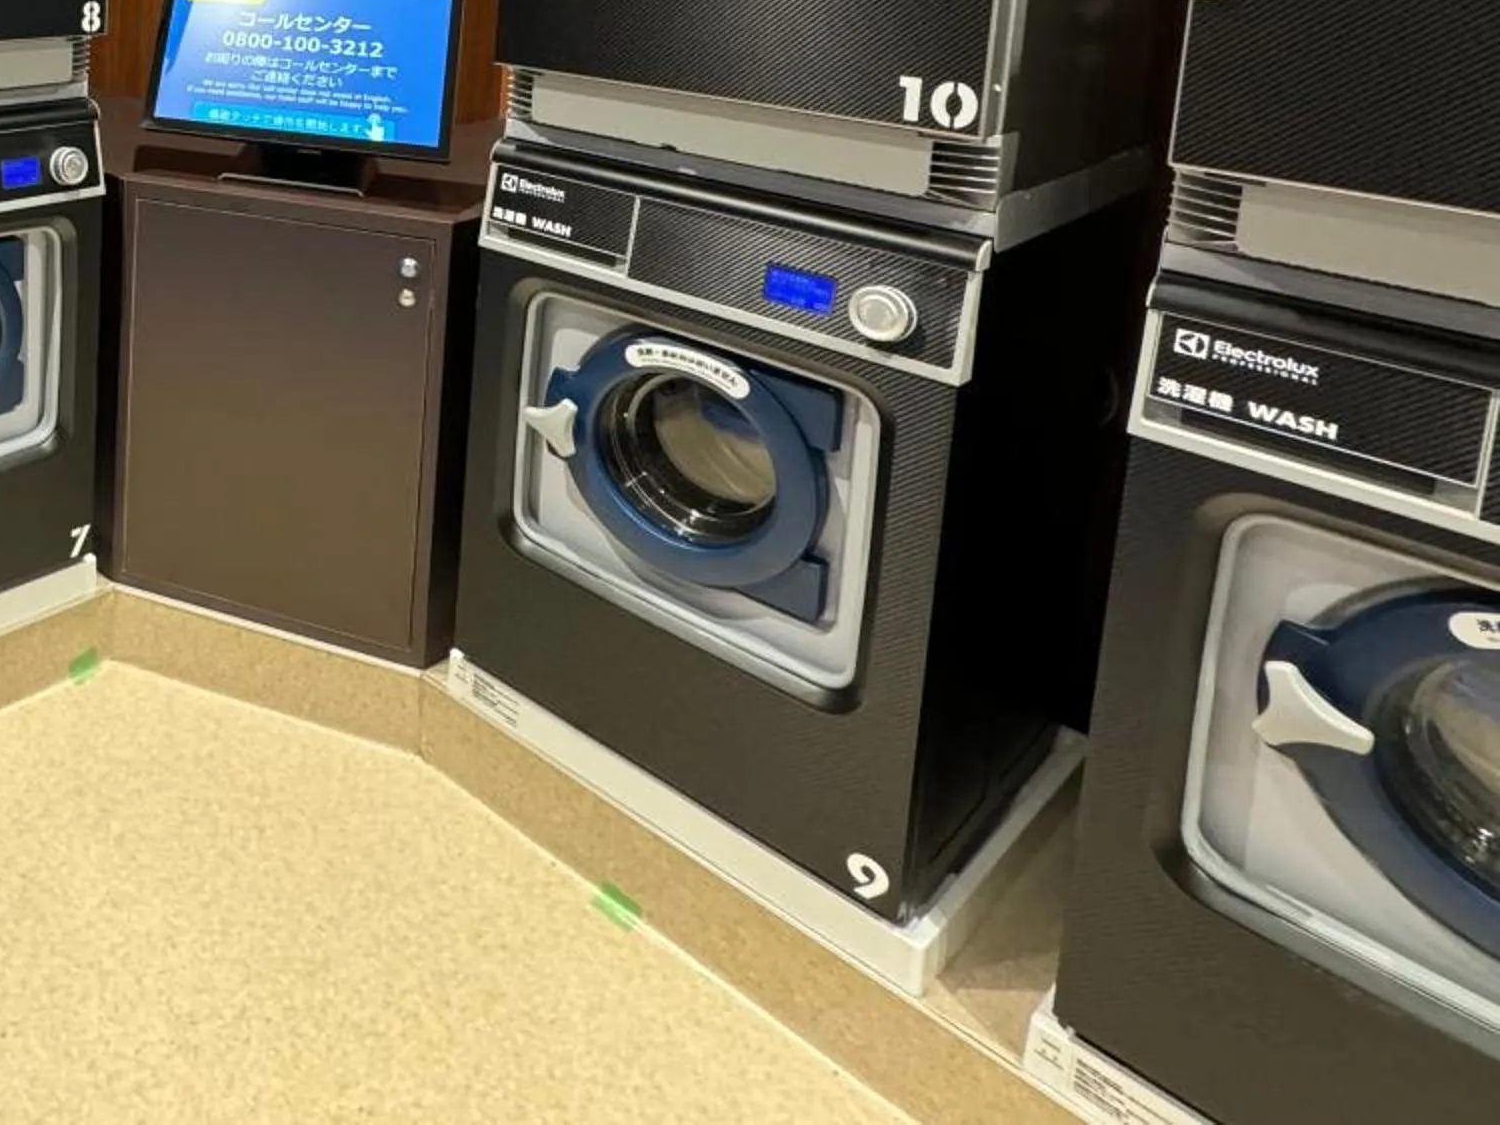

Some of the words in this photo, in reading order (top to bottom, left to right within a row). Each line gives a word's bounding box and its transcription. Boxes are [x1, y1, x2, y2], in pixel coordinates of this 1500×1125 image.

[81, 0, 101, 33] 8
[239, 10, 373, 34] コールセンター
[222, 30, 384, 58] 0800-100-3212
[899, 75, 979, 129] 10
[531, 216, 573, 238] WASH
[1213, 340, 1320, 378] Electrolux
[1248, 401, 1339, 440] WASH
[70, 523, 91, 558] 7
[846, 852, 890, 900] 9
